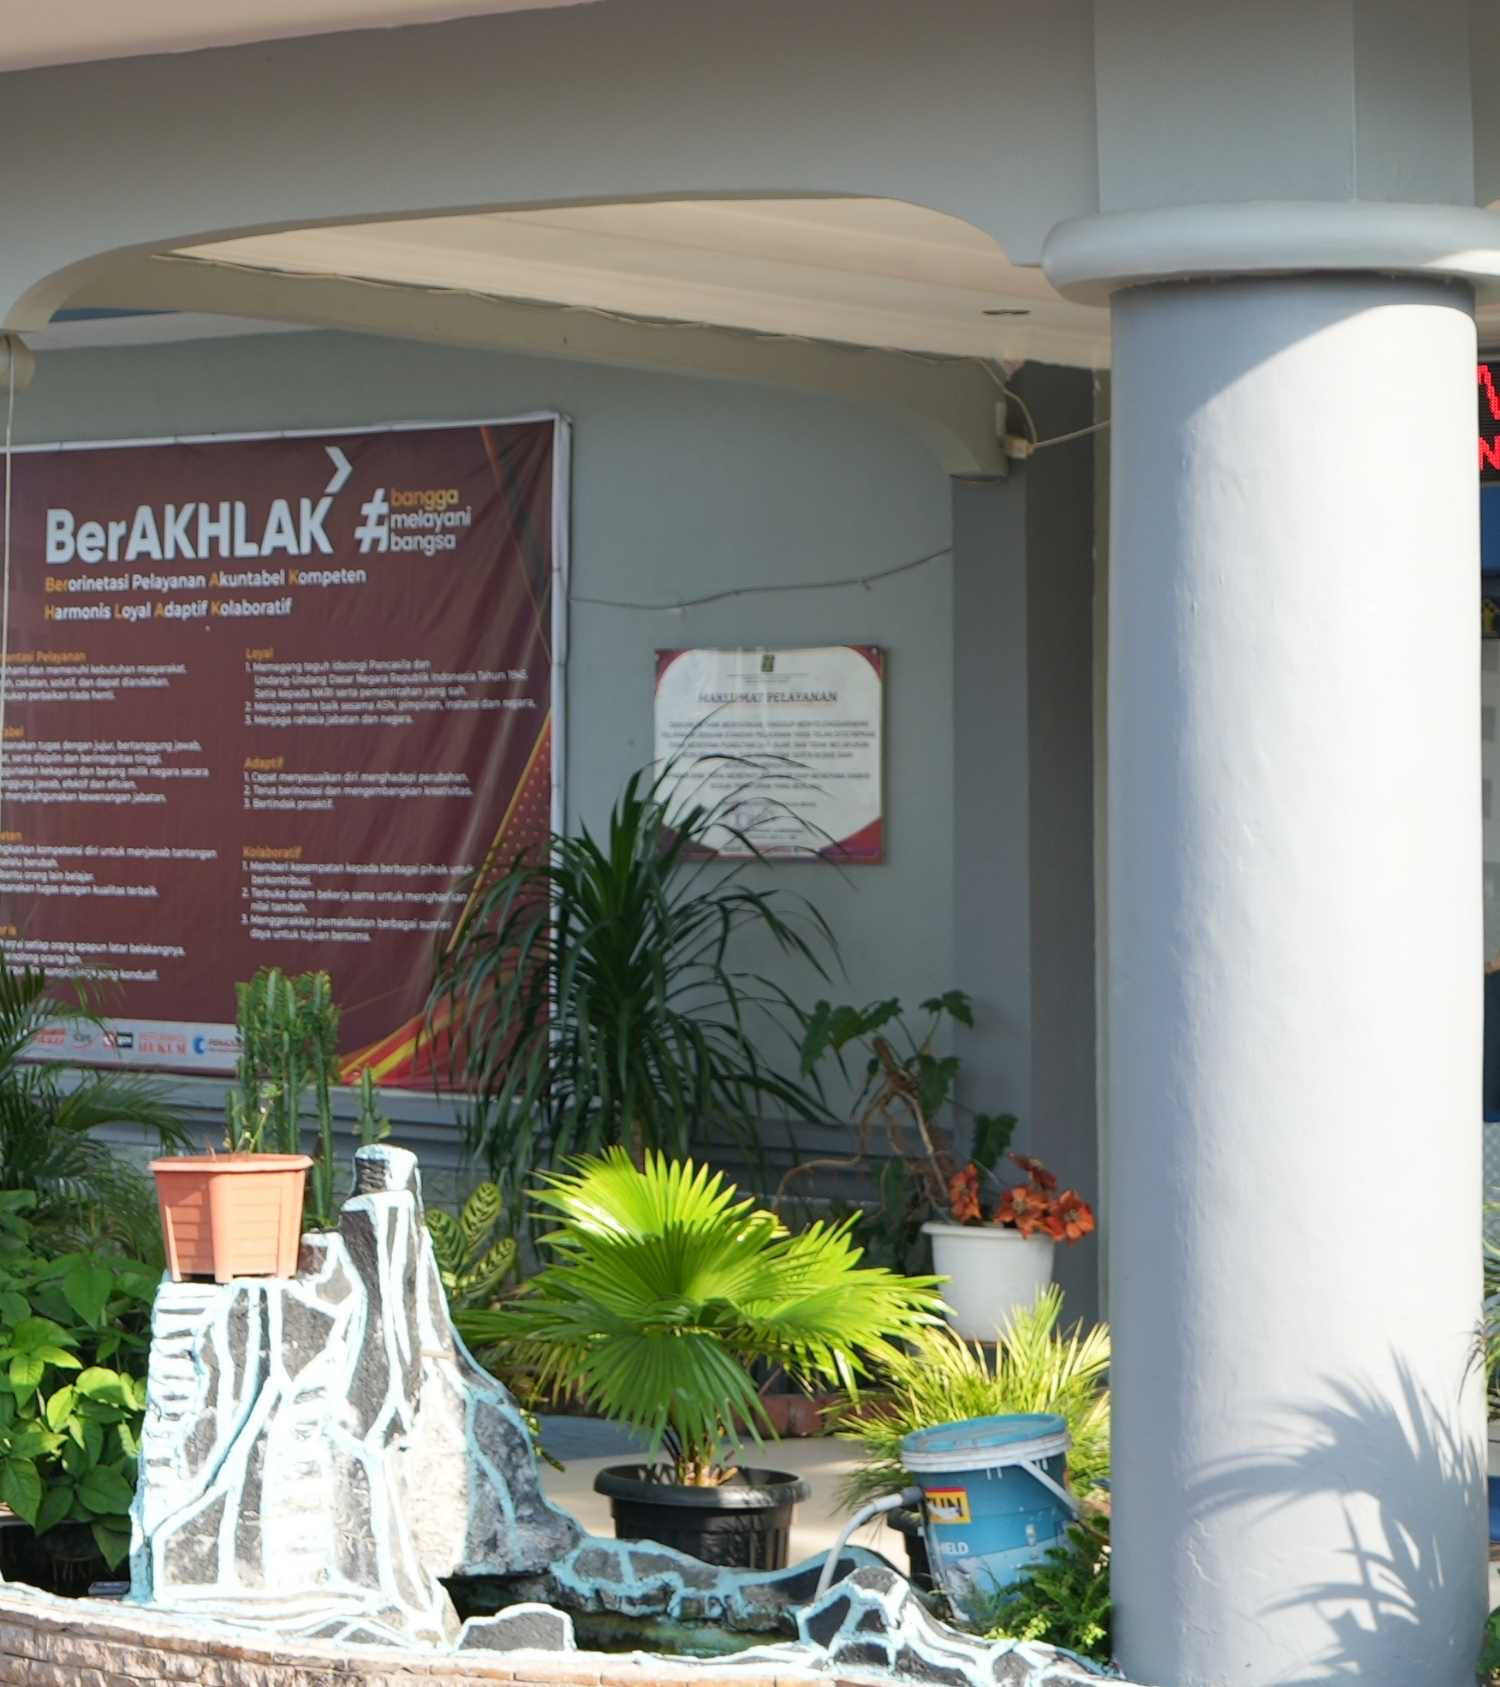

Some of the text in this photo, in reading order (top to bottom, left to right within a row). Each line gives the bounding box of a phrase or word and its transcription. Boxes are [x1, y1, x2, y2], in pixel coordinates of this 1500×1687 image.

[390, 488, 458, 510] bangga
[45, 496, 334, 563] BerAKHLAK
[390, 506, 471, 531] melayani
[390, 530, 456, 556] bangsa
[132, 571, 206, 593] Pelayanan
[208, 568, 285, 588] Akuntabel
[288, 566, 367, 588] Kompeten
[45, 596, 292, 622] Harmonis Loyal Adaptif Kolaboratif
